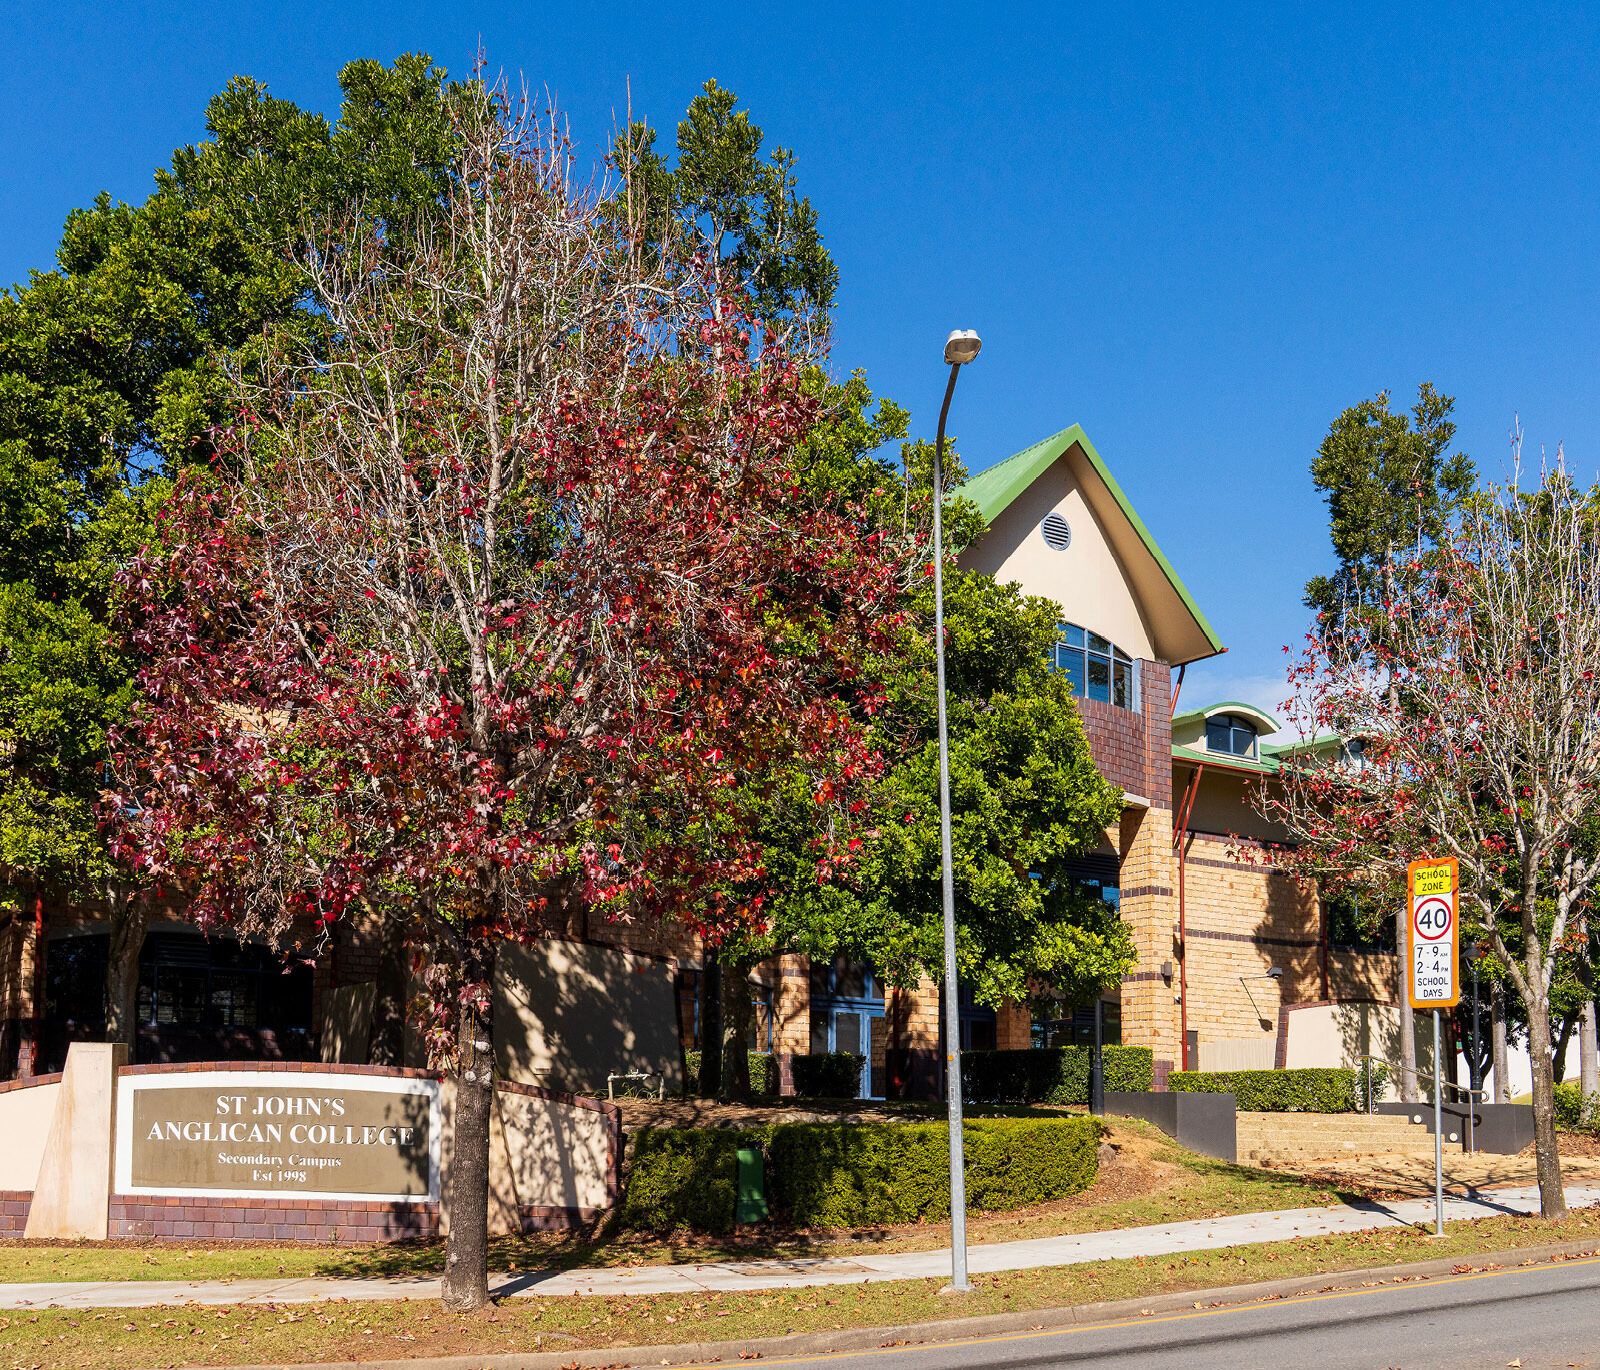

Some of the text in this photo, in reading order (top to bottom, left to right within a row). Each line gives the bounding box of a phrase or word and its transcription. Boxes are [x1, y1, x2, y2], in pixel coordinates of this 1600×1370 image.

[1416, 869, 1449, 881] SCHOOL
[1422, 882, 1444, 892] ZONE
[1419, 908, 1447, 930] 40
[1417, 976, 1449, 987] SCHOOL
[1423, 988, 1443, 998] DAYS
[216, 1095, 247, 1116] ST
[147, 1121, 415, 1147] ANGLICAN COLLEGE
[217, 1151, 342, 1169] Secondary Campus
[252, 1169, 307, 1183] Est 1998
